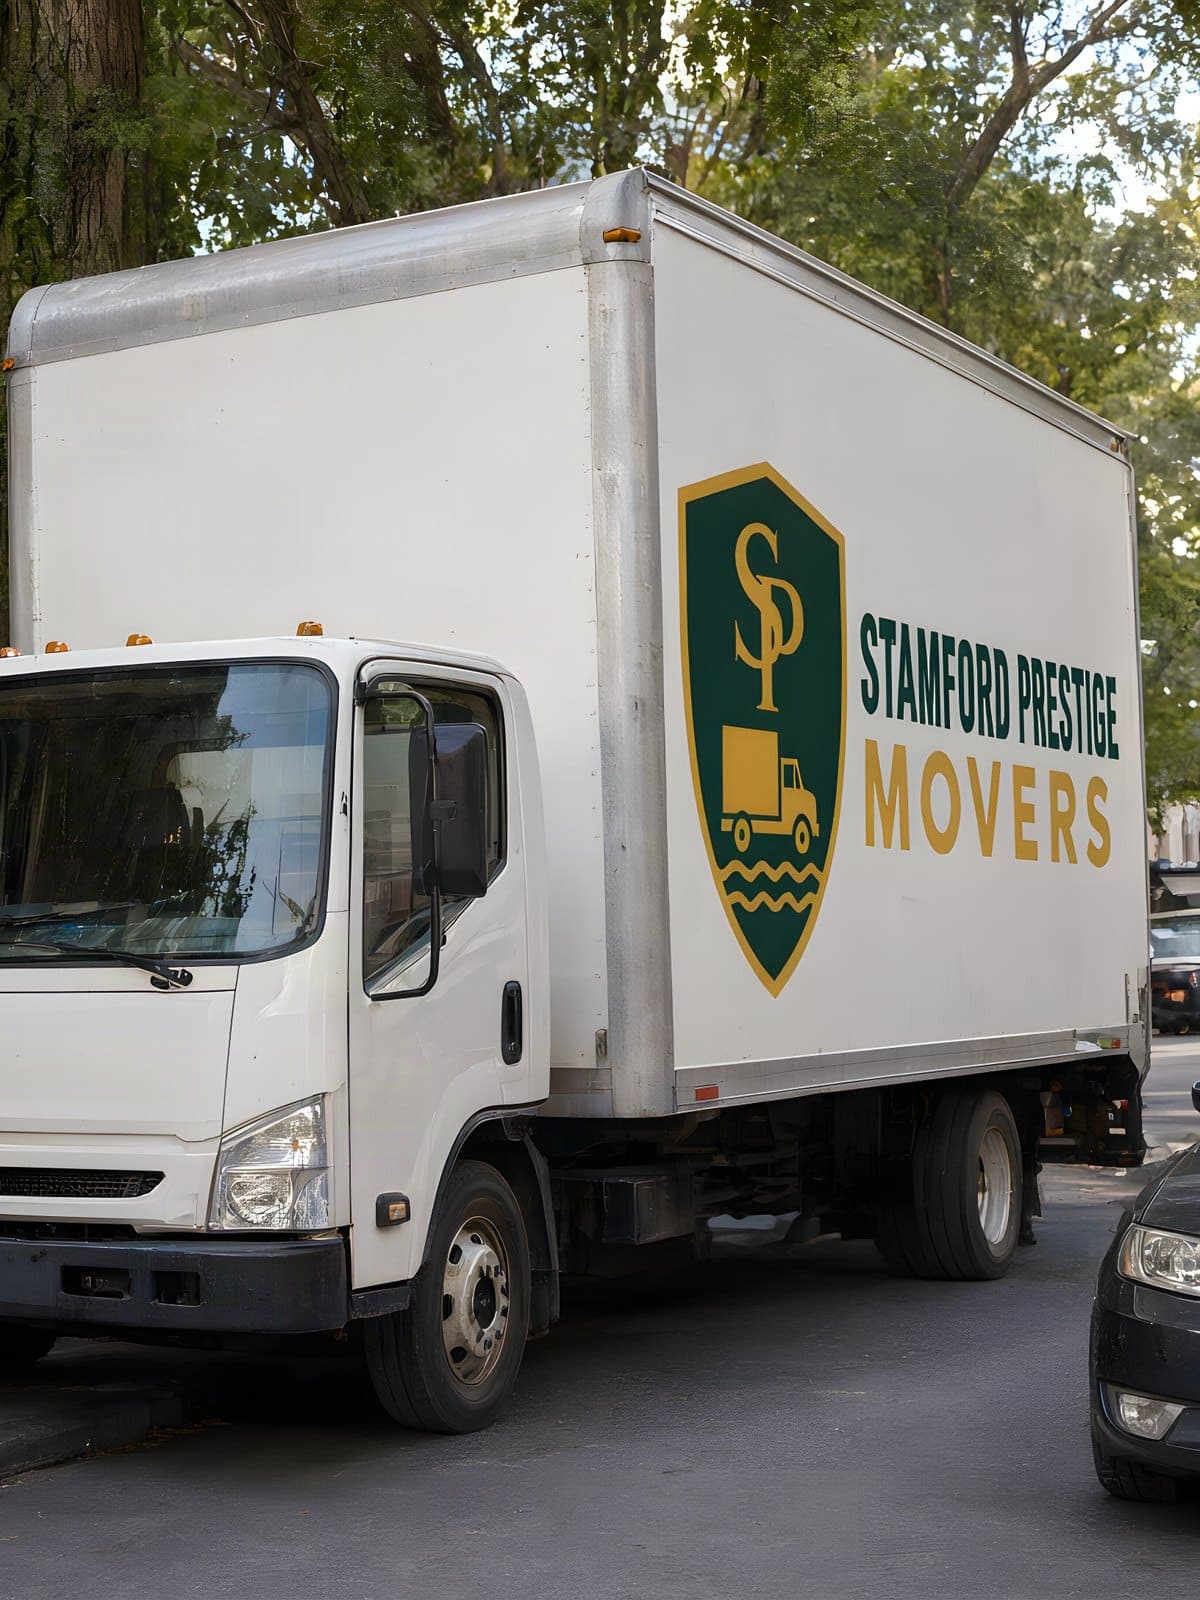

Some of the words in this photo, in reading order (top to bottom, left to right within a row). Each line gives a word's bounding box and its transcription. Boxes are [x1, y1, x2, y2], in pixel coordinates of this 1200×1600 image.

[860, 612, 1010, 740] STAMFORD
[1017, 653, 1120, 761] PRESTIGE
[864, 738, 1112, 869] MOVERS
